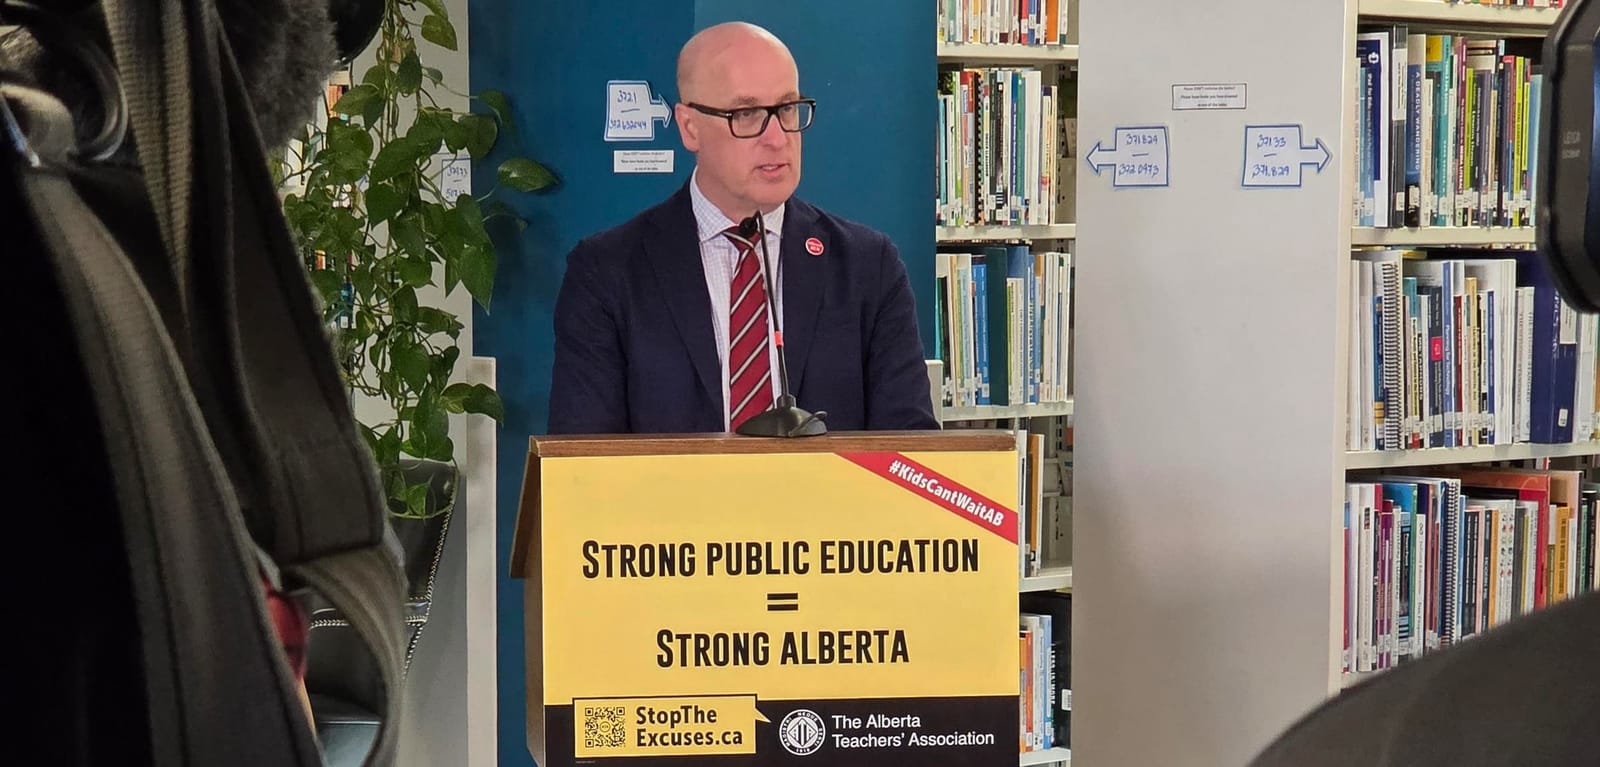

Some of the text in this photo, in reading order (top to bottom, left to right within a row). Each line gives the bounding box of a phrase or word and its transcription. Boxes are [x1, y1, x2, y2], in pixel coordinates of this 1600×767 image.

[888, 460, 1004, 526] #KidsCantWaitAB
[706, 540, 810, 575] PUBLIC
[820, 538, 979, 574] EDUCATION
[780, 629, 910, 665] ALBERTA
[636, 705, 717, 728] StopThe
[831, 713, 922, 729] The Alberta
[636, 727, 743, 747] Excuses.ca
[831, 730, 995, 749] Teachers' Association
